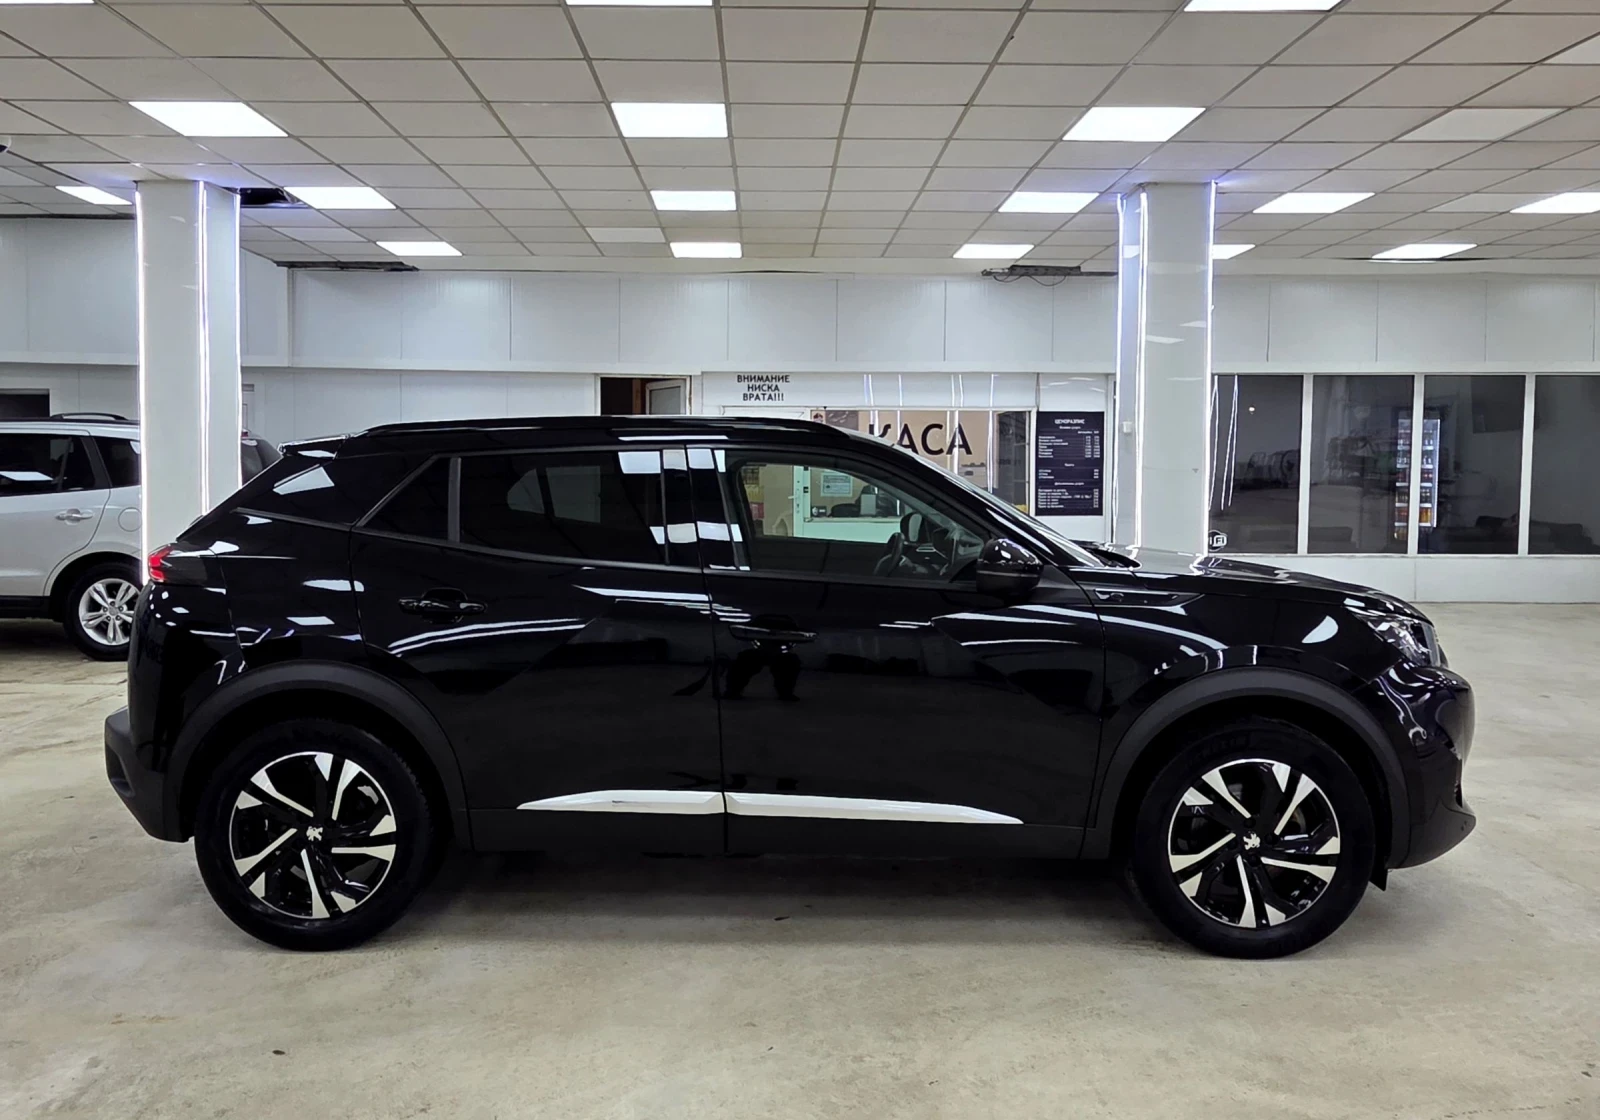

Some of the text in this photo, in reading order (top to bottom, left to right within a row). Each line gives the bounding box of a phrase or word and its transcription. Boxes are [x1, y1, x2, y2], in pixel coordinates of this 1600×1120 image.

[737, 374, 790, 383] ВНИМАНИЕ
[747, 383, 780, 392] НИСКА
[742, 393, 784, 401] ВРАТА!!!
